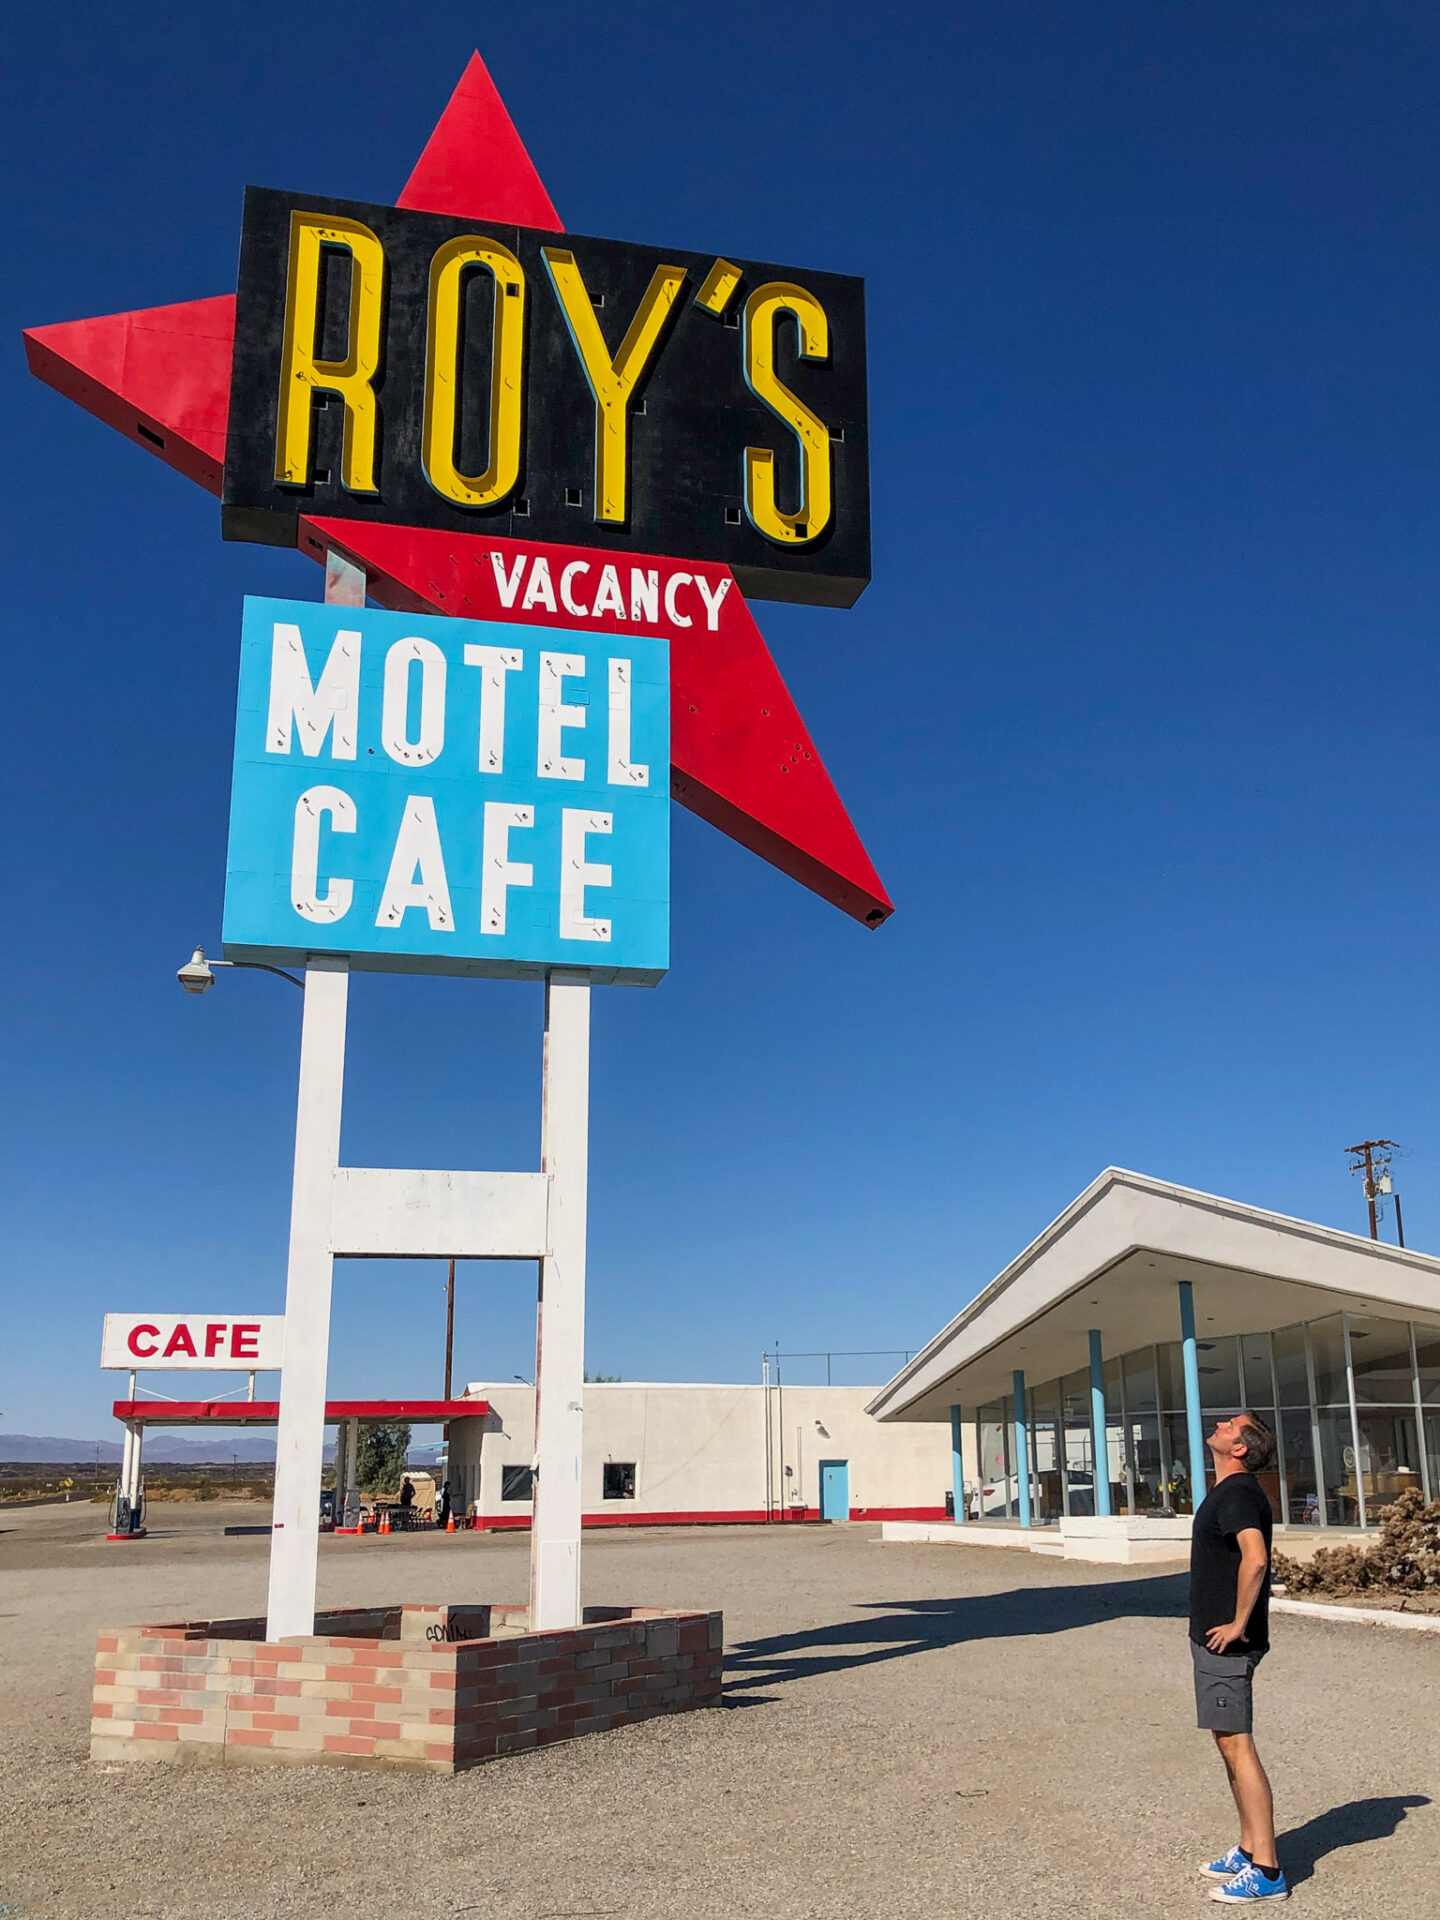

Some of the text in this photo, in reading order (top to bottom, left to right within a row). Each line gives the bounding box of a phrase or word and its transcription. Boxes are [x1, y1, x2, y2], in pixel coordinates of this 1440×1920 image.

[273, 209, 832, 547] ROY'S
[490, 551, 733, 631] VACANCY
[265, 622, 650, 788] MOTEL
[290, 784, 614, 942] CAFE
[127, 1323, 261, 1358] CAFE
